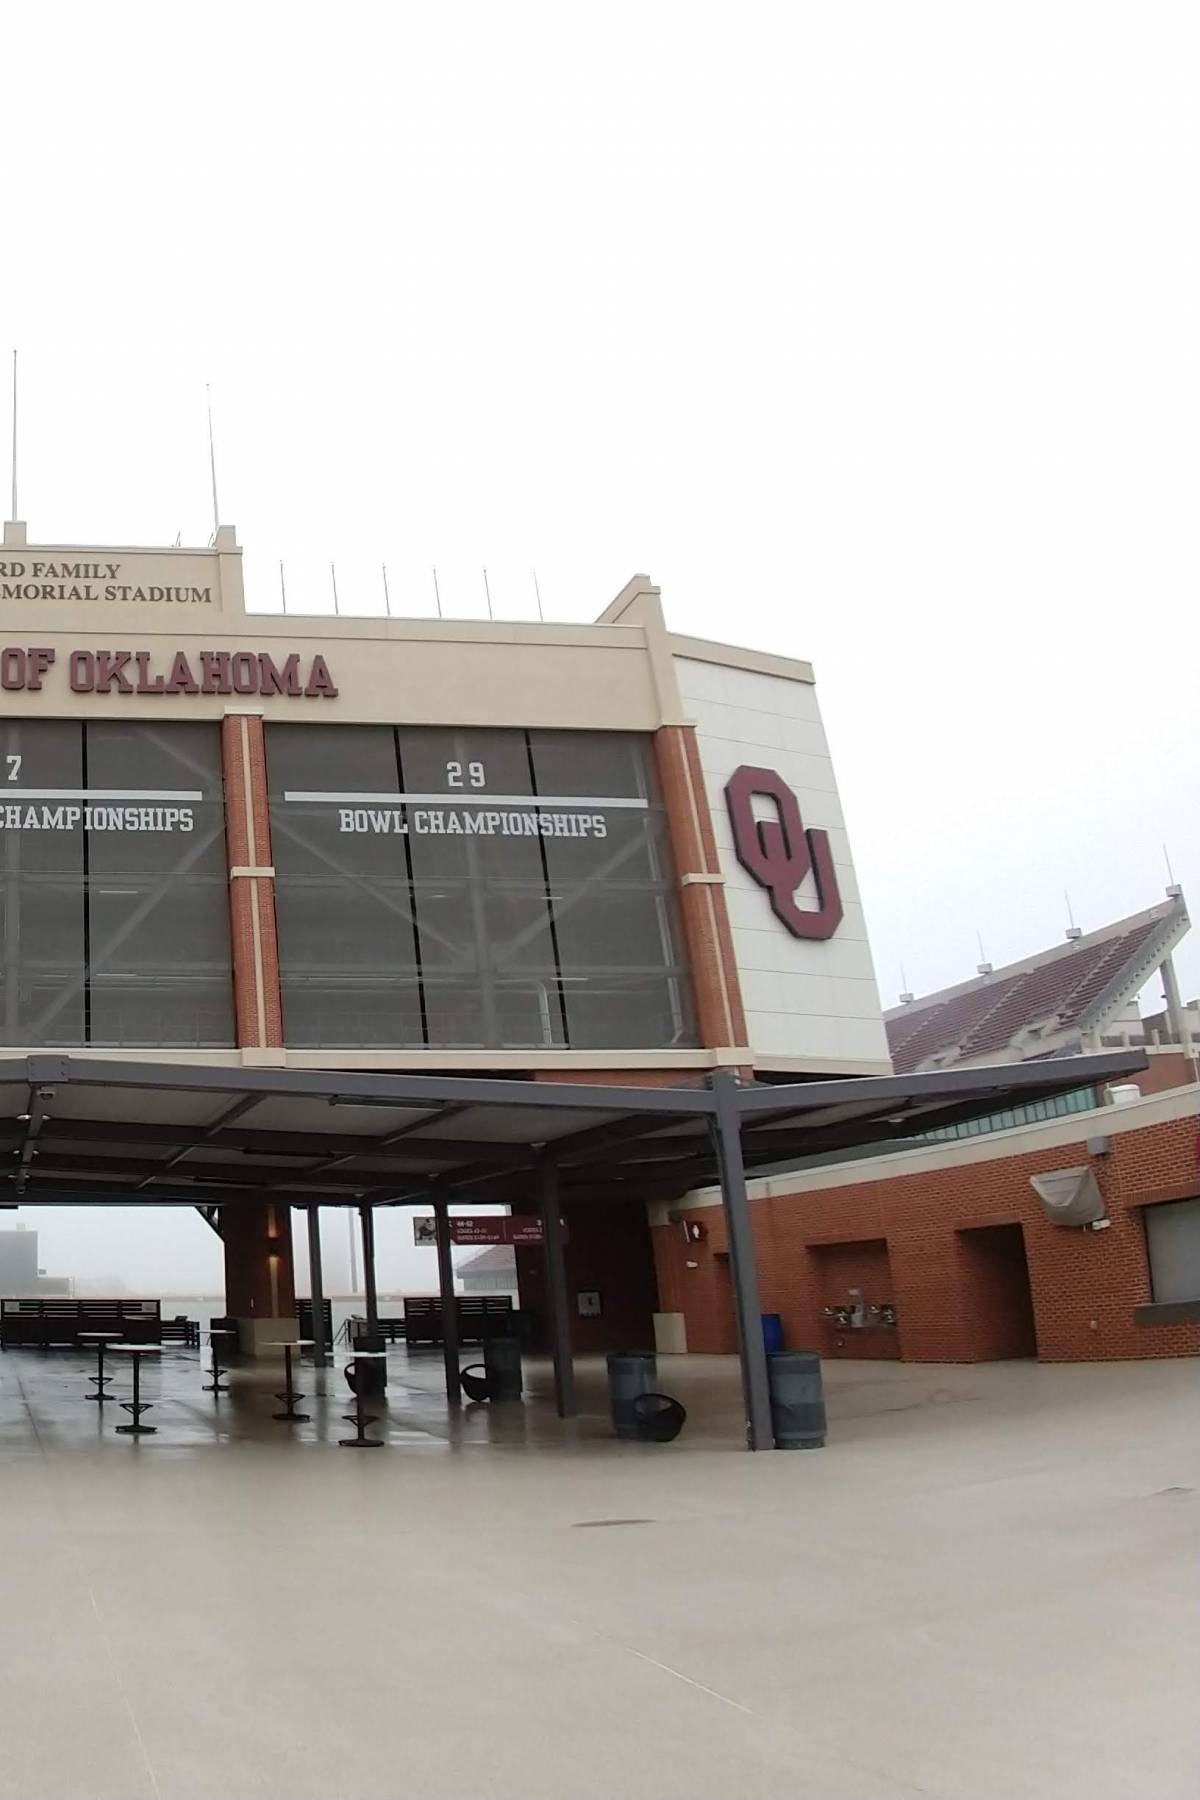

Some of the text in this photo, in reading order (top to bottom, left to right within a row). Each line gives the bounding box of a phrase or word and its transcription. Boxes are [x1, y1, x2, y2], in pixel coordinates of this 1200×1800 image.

[31, 562, 121, 580] FAMILY
[104, 585, 213, 604] STADIUM
[1, 647, 56, 691] OF
[69, 650, 339, 698] OKLAHOMA
[6, 755, 22, 780] 7
[446, 761, 486, 788] 29
[338, 808, 608, 838] BOWL CHAMPIONSHIPS
[723, 764, 845, 941] OU
